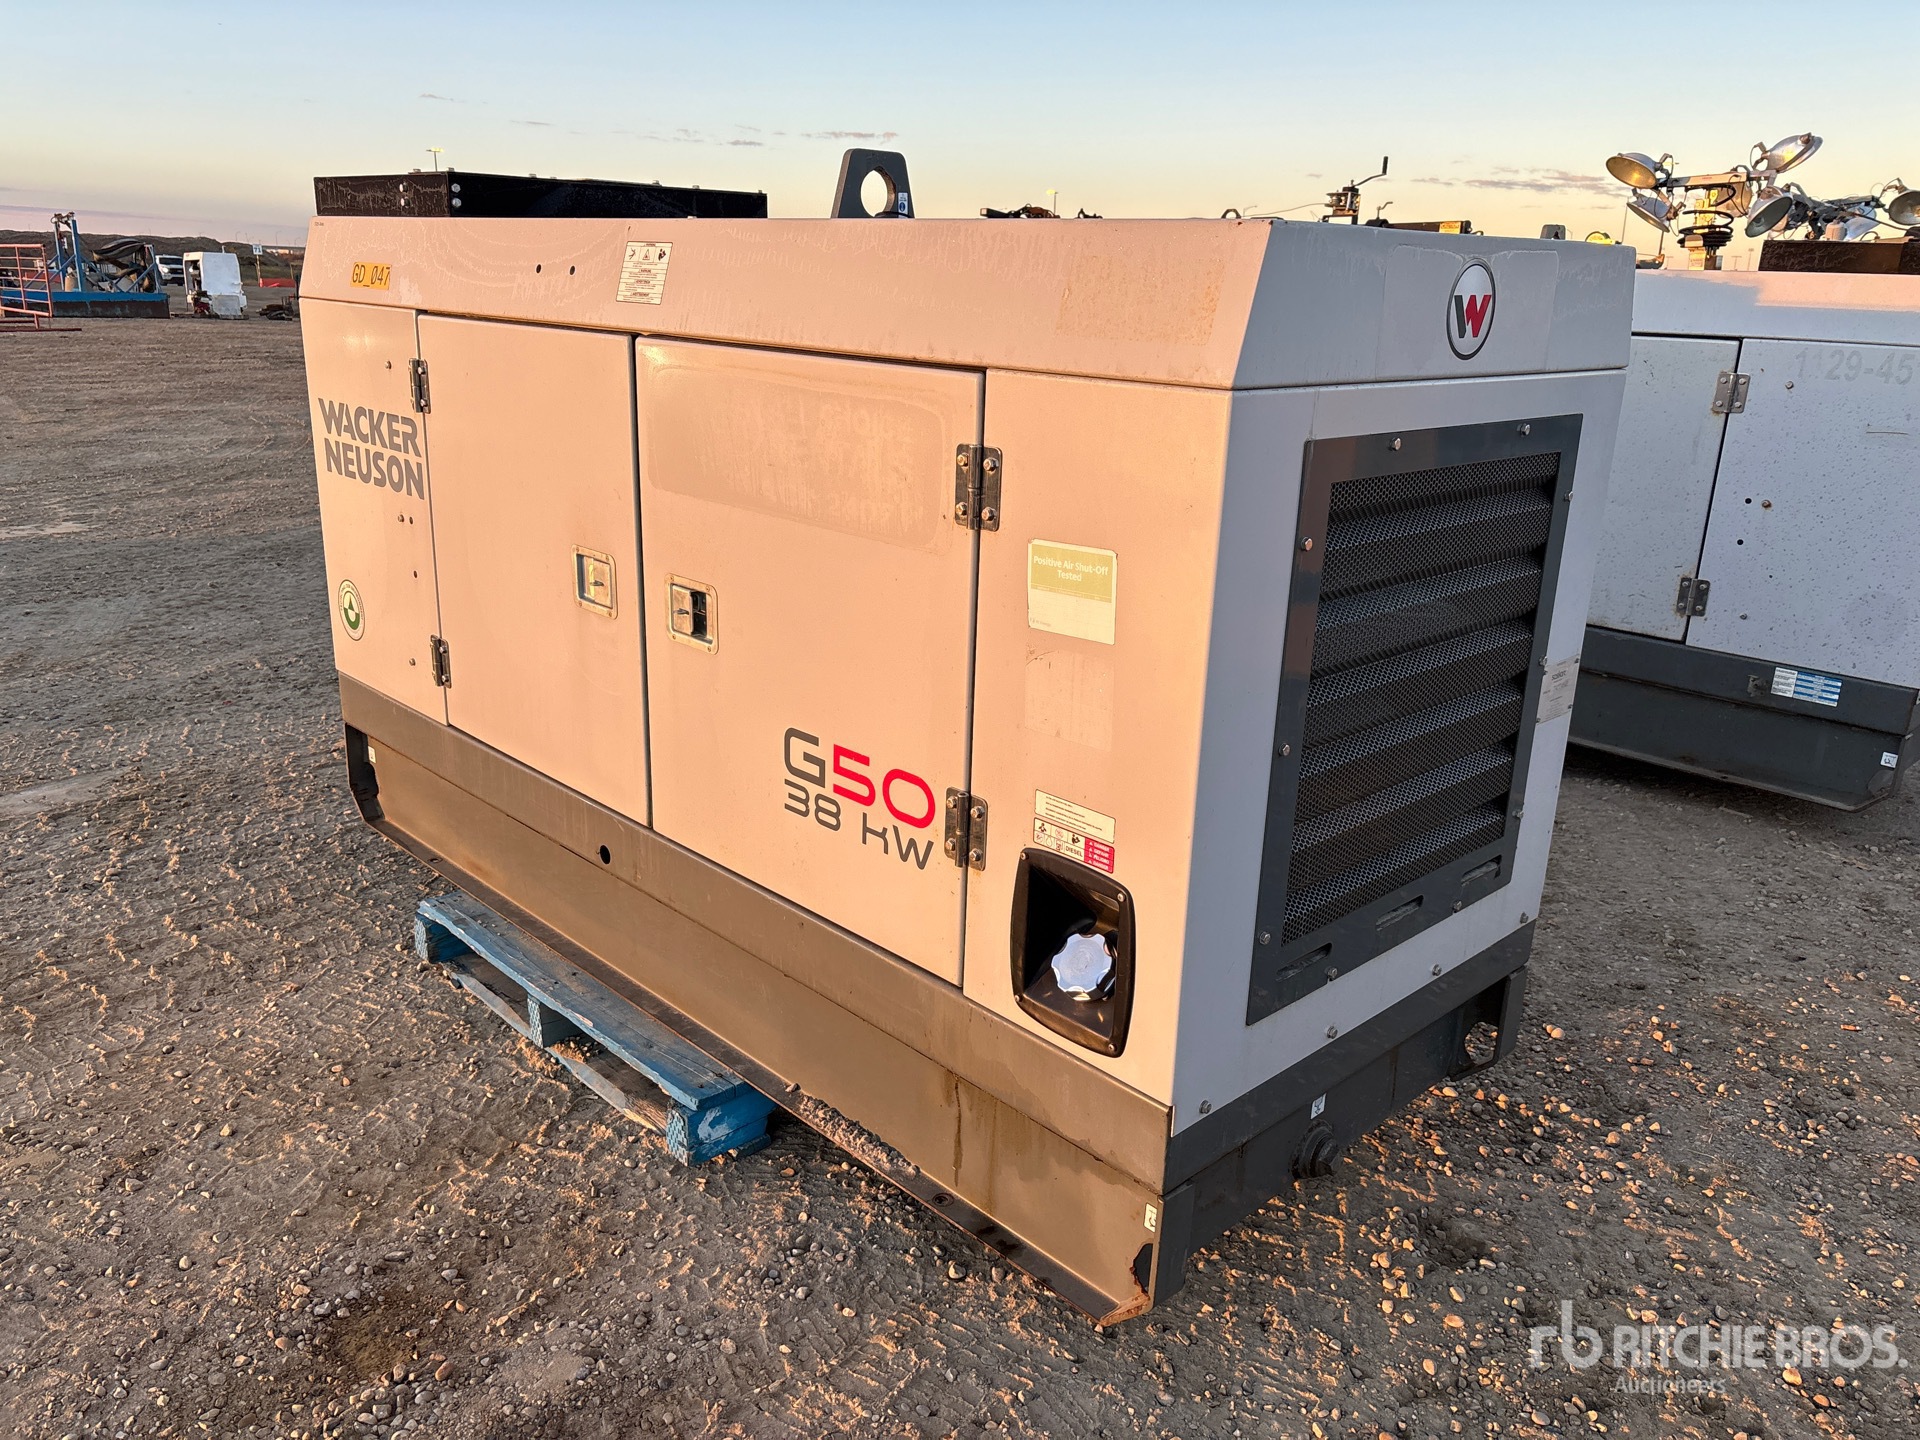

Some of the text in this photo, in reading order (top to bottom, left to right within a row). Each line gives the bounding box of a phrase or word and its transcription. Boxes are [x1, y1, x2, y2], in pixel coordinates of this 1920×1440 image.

[351, 264, 391, 288] GD_047
[1795, 347, 1920, 386] 1129-45
[318, 397, 422, 458] WACKER
[324, 437, 425, 501] NEUSON
[1033, 555, 1109, 576] Positive Air Shut-Off
[1056, 569, 1082, 582] Tested
[784, 727, 936, 829] G50
[784, 778, 841, 832] 38
[1065, 845, 1083, 858] DIESEL
